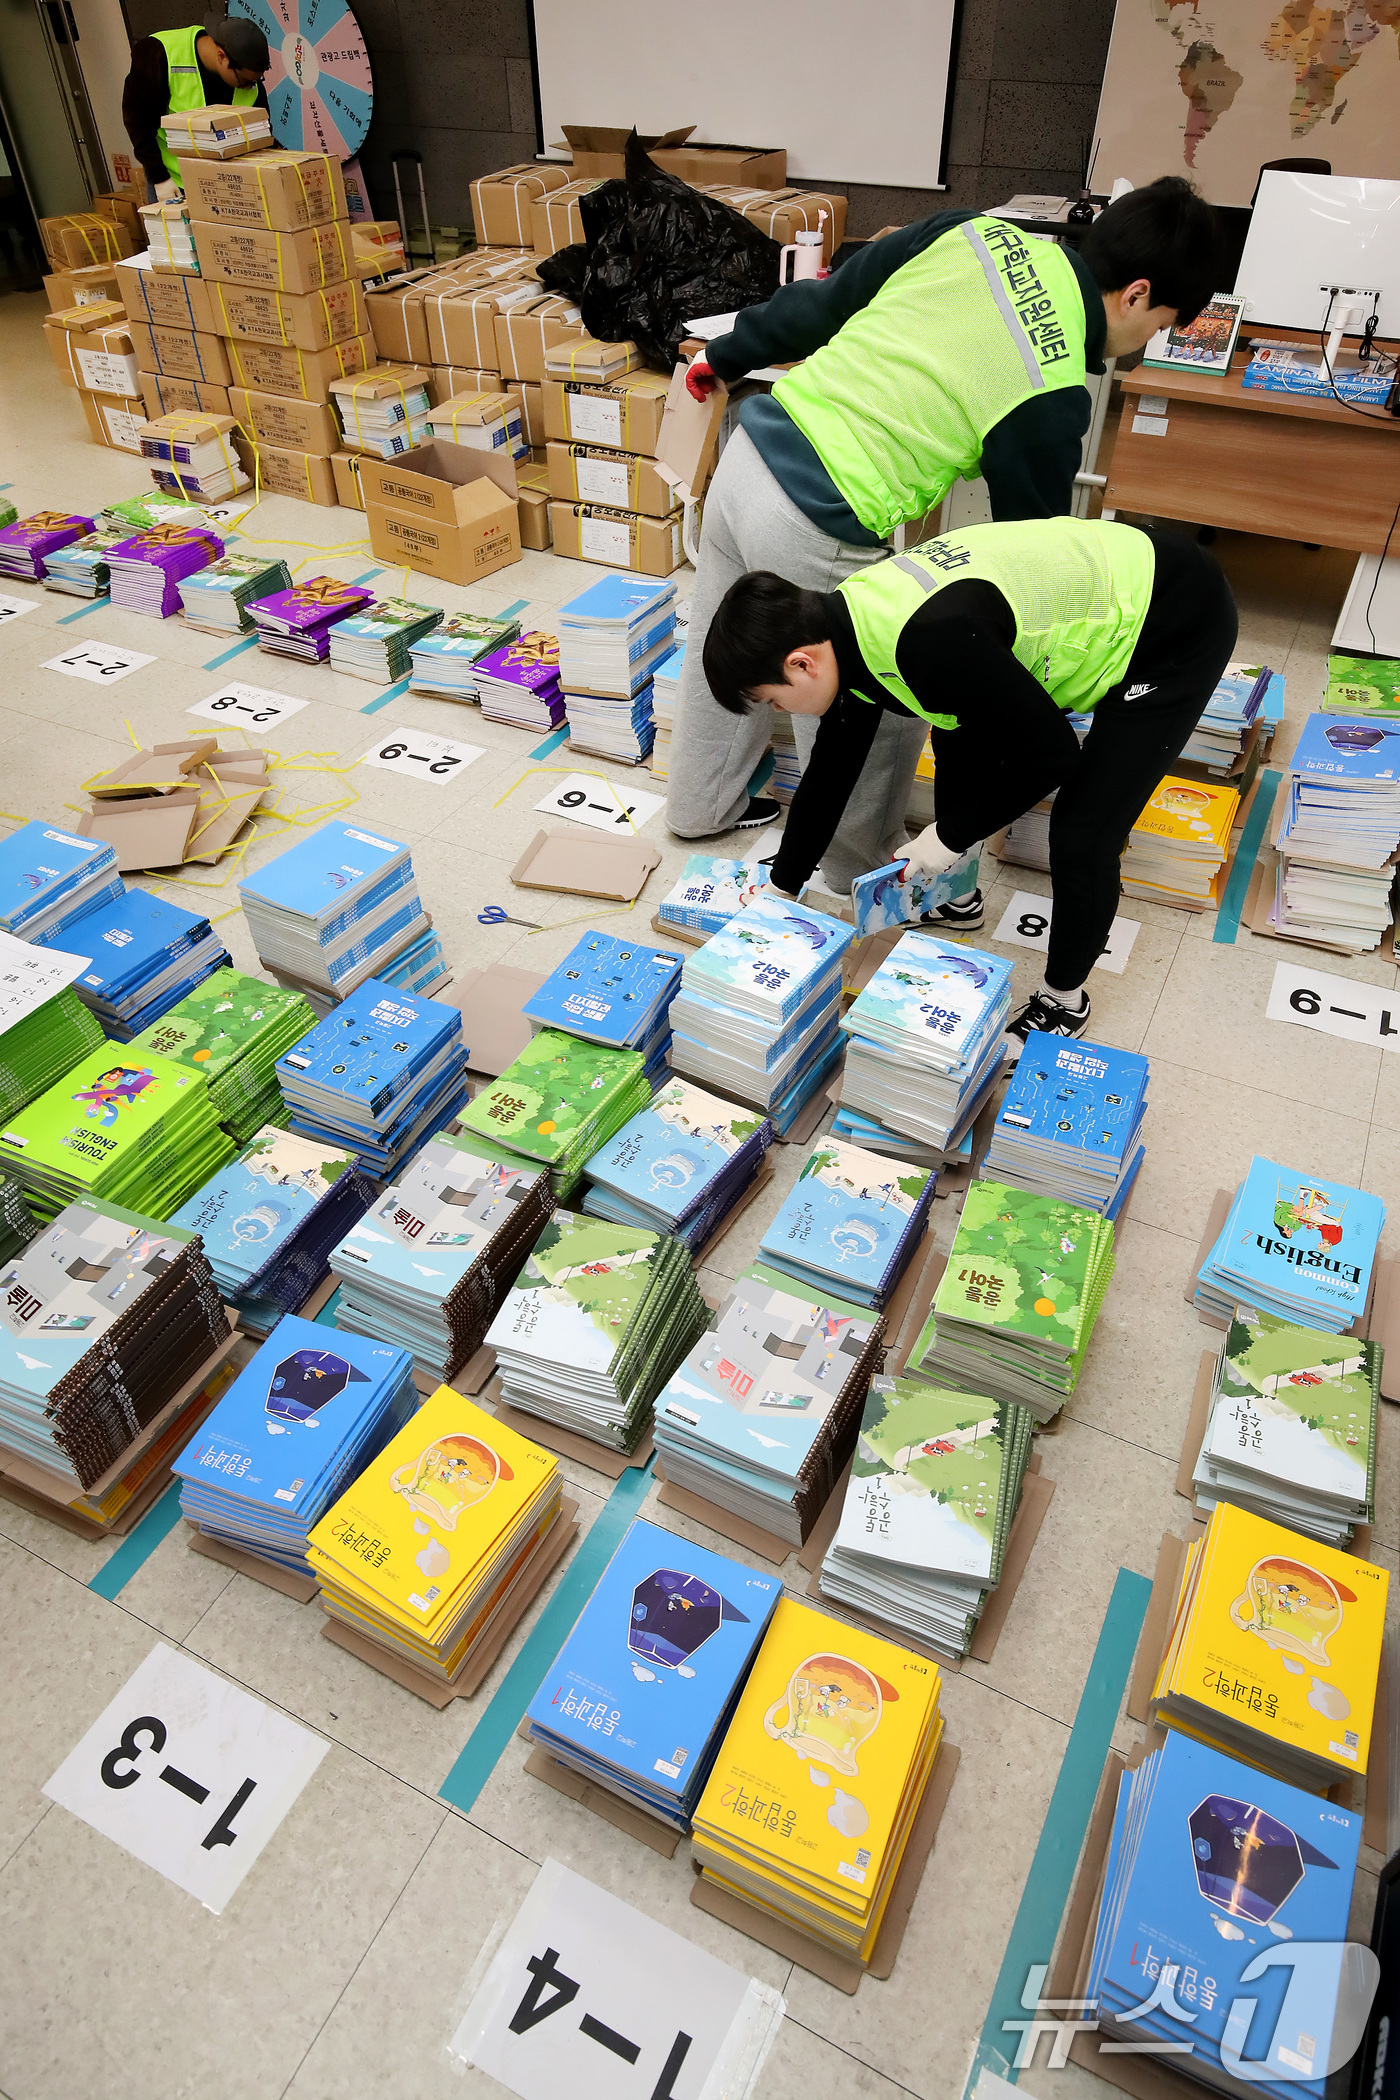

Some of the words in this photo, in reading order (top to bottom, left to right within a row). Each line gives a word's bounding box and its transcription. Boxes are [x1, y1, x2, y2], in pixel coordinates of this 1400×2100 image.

[984, 223, 1070, 366] 대구학교지원센터
[1352, 377, 1387, 387] FILM
[61, 654, 129, 675] 2-7
[1131, 683, 1151, 695] NIKE
[211, 697, 281, 722] 2-8
[379, 743, 462, 774] 2-9
[557, 791, 636, 824] 1-6
[684, 887, 700, 901] 공통
[753, 973, 781, 990] 공통
[1290, 988, 1398, 1035] 1-9
[925, 1016, 955, 1035] 공통
[148, 1037, 175, 1053] 공통
[487, 1105, 516, 1124] 공통
[58, 1135, 108, 1161] TOURISM
[69, 1125, 118, 1151] ENGLISH
[634, 1133, 643, 1143] 2
[218, 1190, 229, 1200] 2
[804, 1203, 813, 1213] 2
[393, 1207, 425, 1239] 미술
[1240, 1229, 1254, 1245] 2
[1256, 1234, 1362, 1285] English
[1293, 1267, 1360, 1294] Common
[6, 1284, 43, 1322] 미술
[532, 1289, 539, 1299] 1
[965, 1286, 1001, 1307] 공통
[1337, 1291, 1355, 1302] High
[716, 1357, 754, 1398] 미술
[1246, 1399, 1252, 1409] 1
[876, 1477, 882, 1489] 1
[100, 1716, 258, 1851] 1-3
[508, 1947, 693, 2100] 1-4
